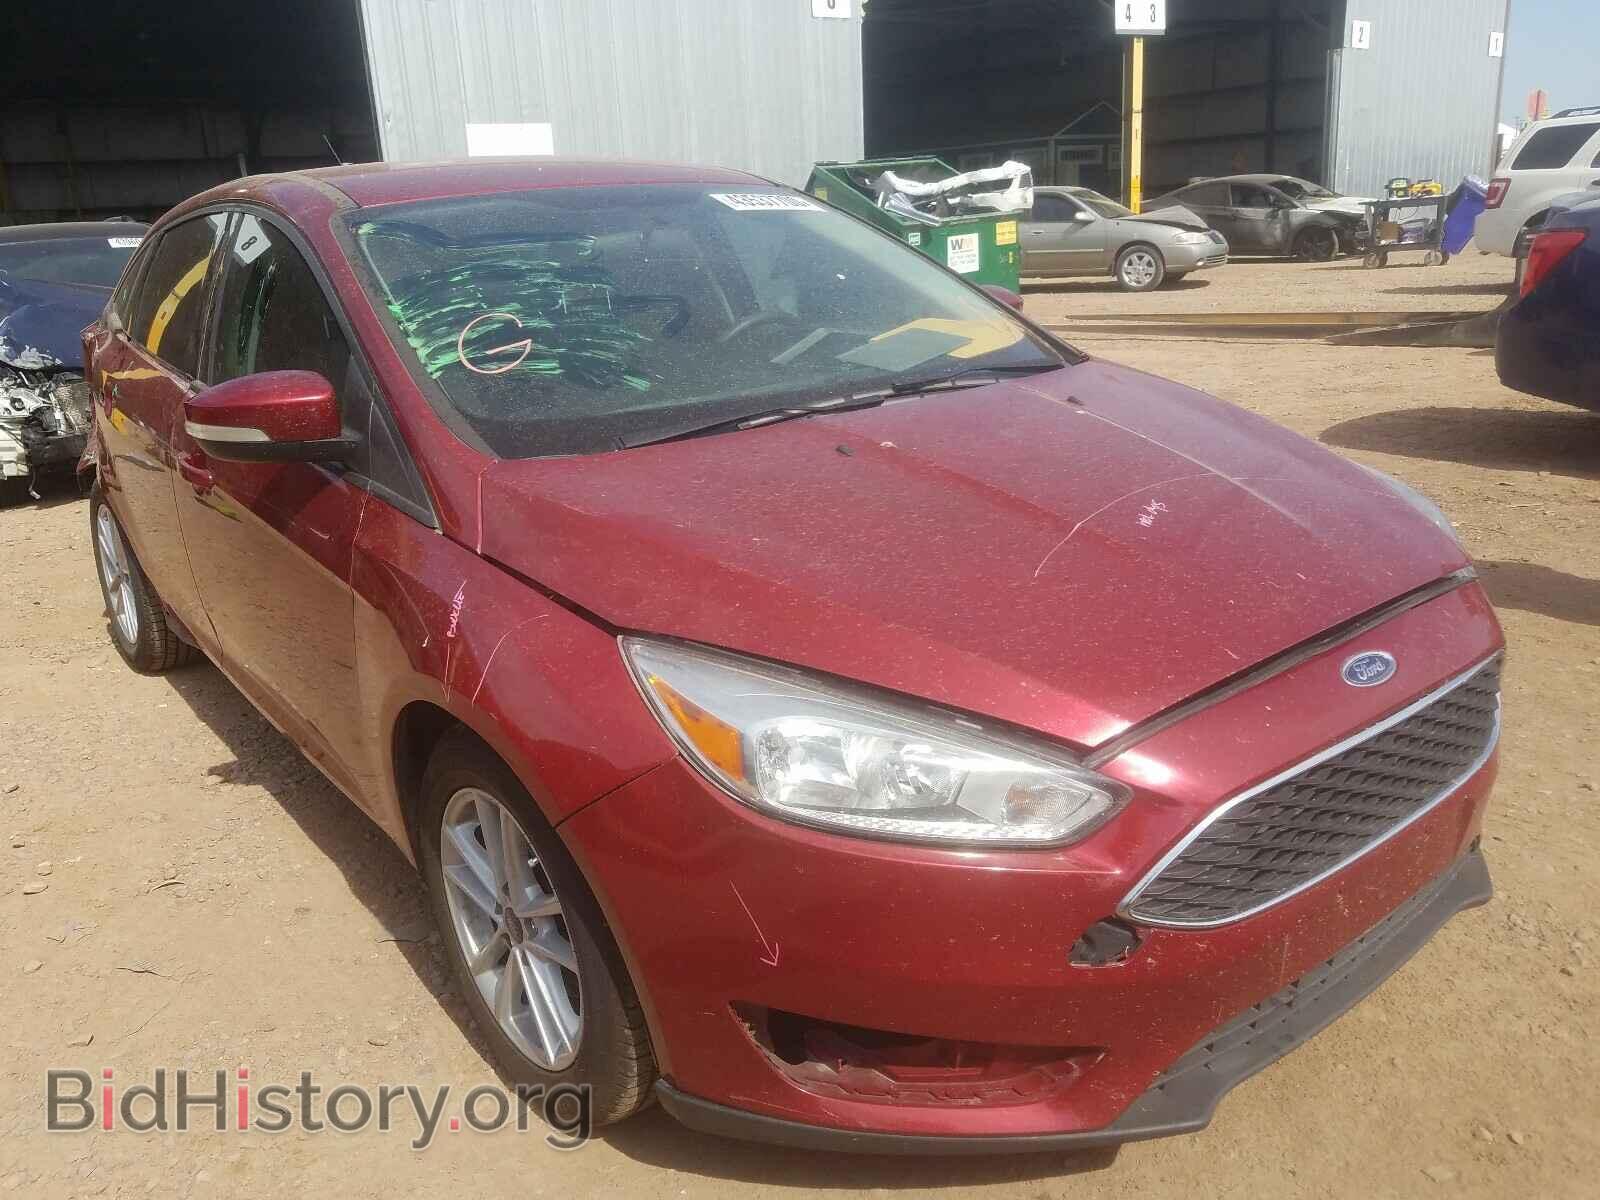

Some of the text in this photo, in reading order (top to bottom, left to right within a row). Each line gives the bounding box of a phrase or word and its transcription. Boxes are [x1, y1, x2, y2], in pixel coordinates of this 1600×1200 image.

[1125, 3, 1156, 23] 4 3
[1358, 26, 1364, 43] 2
[458, 312, 532, 374] G
[1353, 658, 1386, 681] Ford
